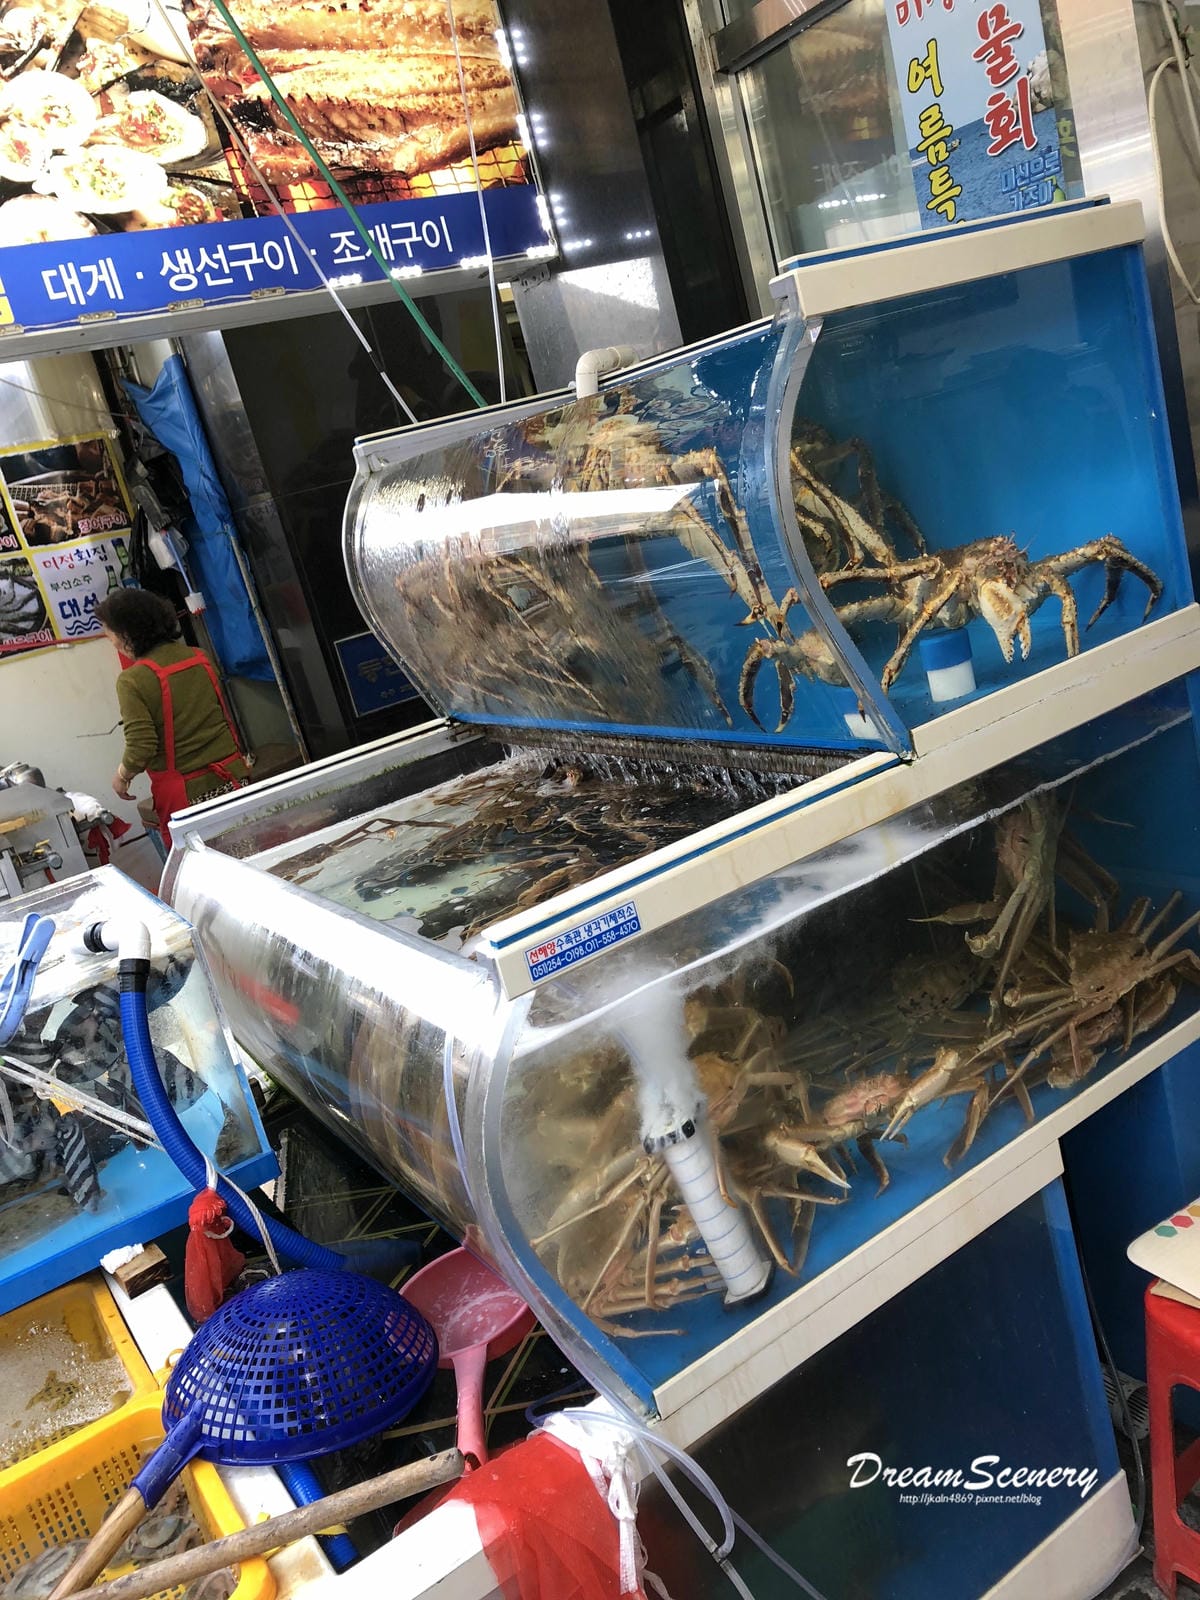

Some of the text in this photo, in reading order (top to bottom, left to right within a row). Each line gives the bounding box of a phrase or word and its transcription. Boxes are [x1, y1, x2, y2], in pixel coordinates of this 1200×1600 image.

[972, 3, 1037, 157] 물회
[41, 215, 454, 306] 대게 생선구이 조개구이
